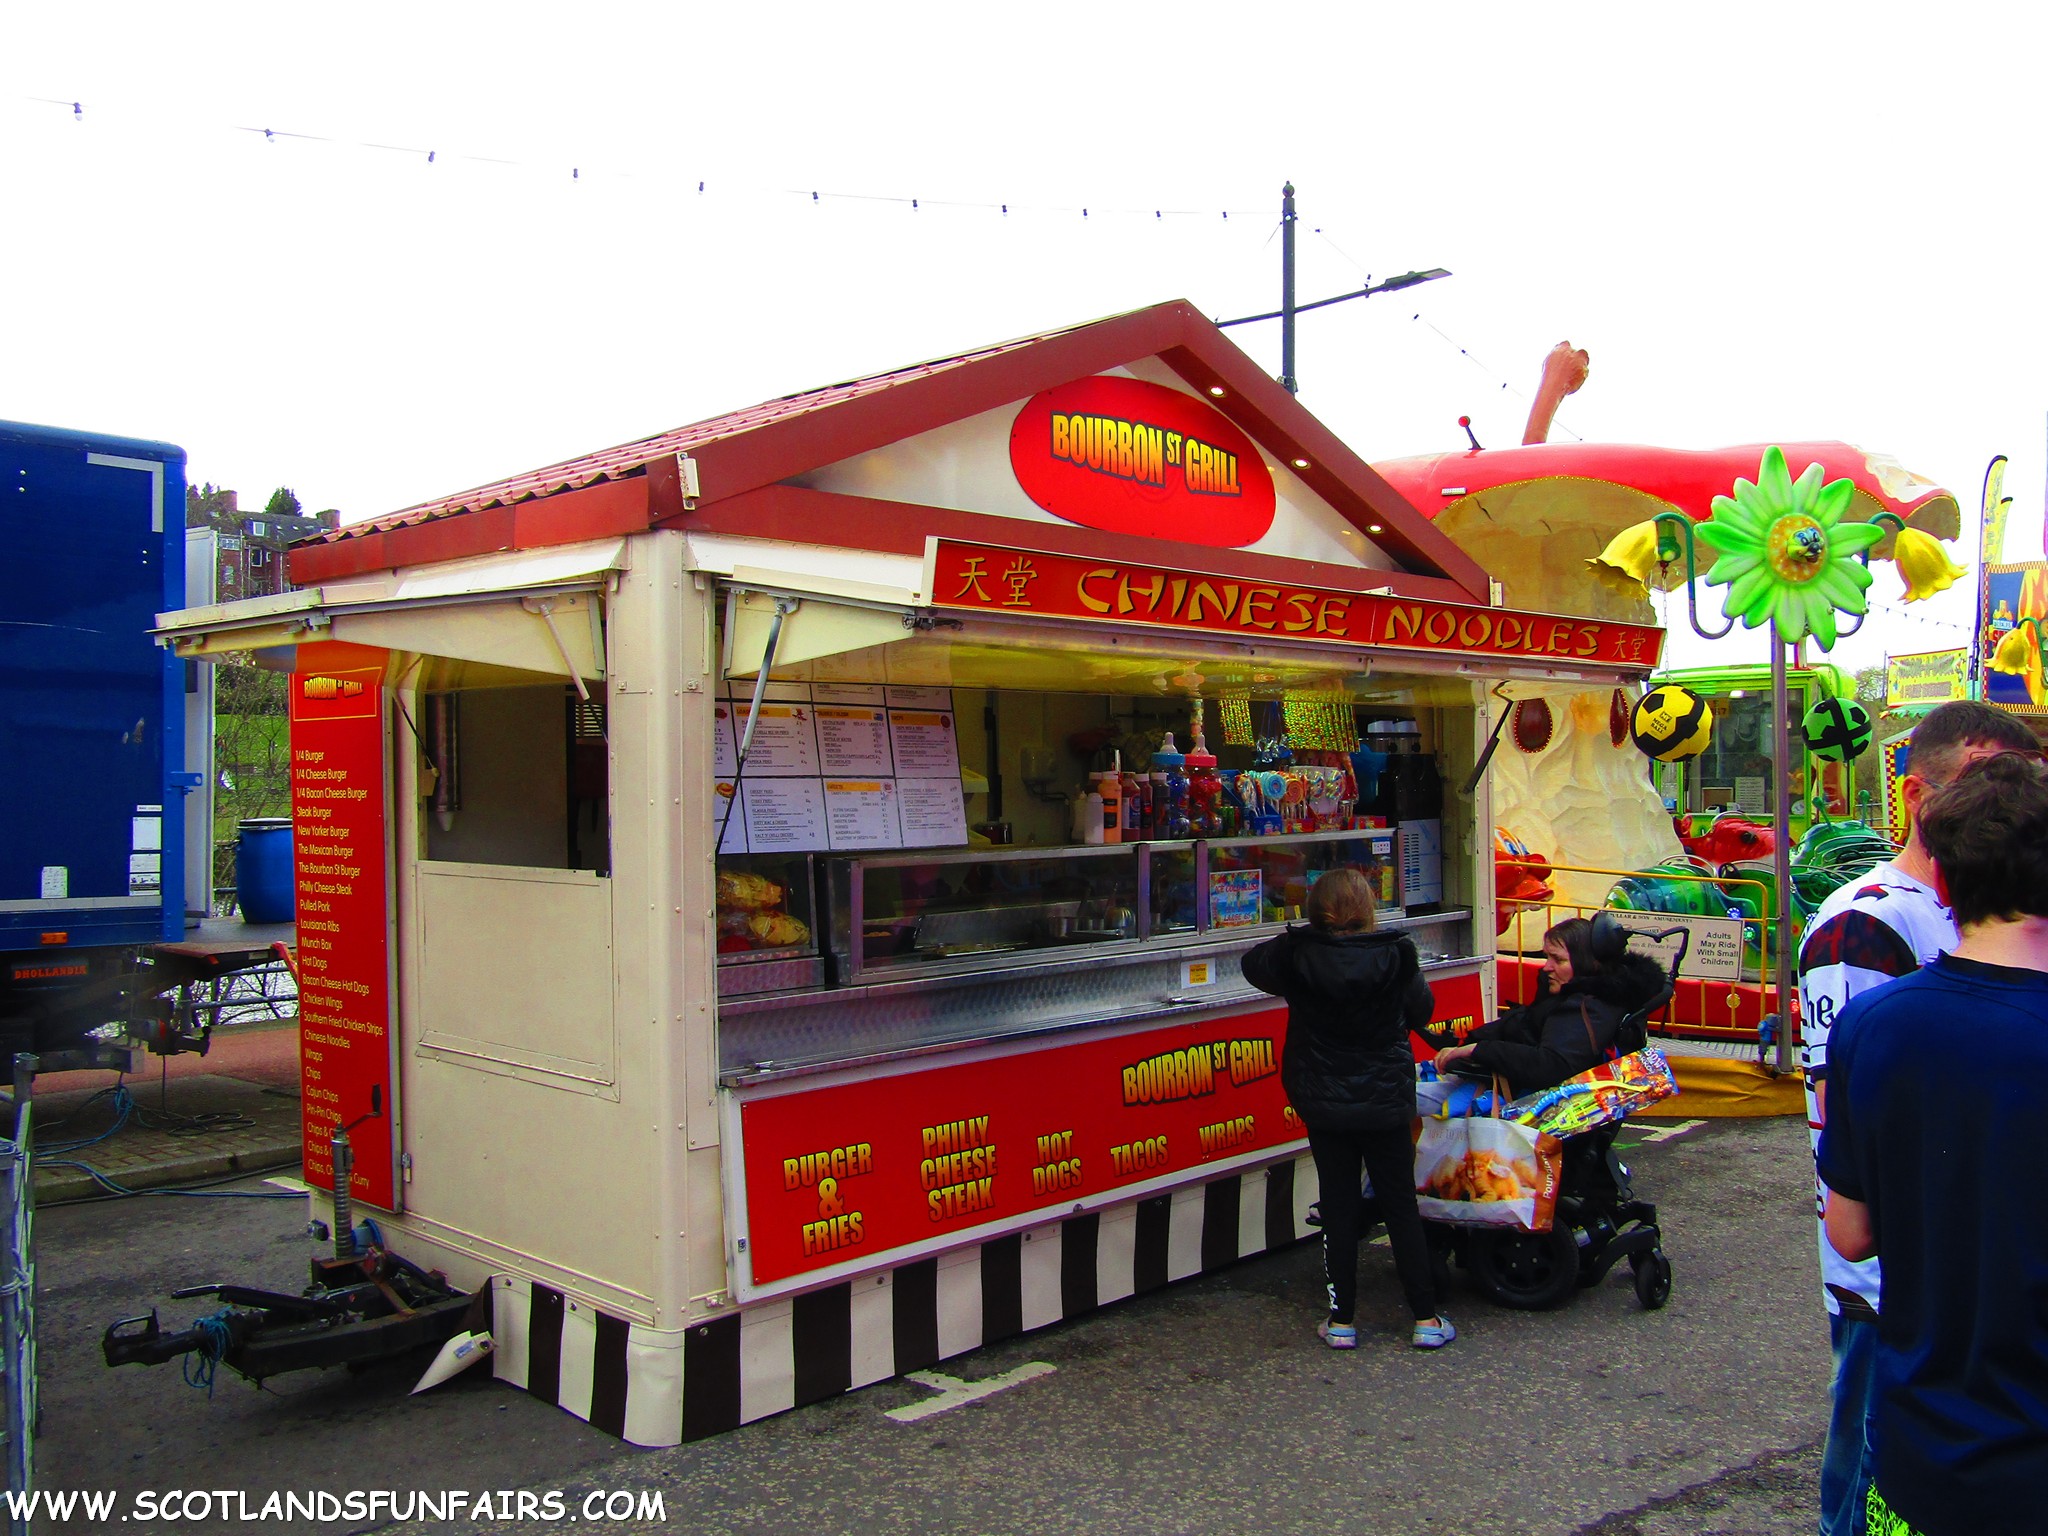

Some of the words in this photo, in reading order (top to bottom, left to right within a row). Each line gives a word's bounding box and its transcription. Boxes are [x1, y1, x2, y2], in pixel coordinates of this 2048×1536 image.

[1051, 412, 1164, 486] BOURBON
[1166, 431, 1181, 466] ST
[1184, 438, 1240, 494] GRILL
[953, 556, 1037, 606] 天堂
[1077, 568, 1352, 637] CHINESE
[1384, 605, 1600, 656] NOODLES
[1650, 723, 1662, 734] BALL
[1653, 718, 1667, 730] MEGA
[305, 750, 324, 762] Burger
[306, 769, 327, 780] Cheese
[327, 770, 347, 782] Burger
[306, 788, 324, 799] Bacon
[324, 788, 346, 799] Cheese
[347, 789, 367, 801] Burger
[297, 806, 312, 818] Steak
[313, 808, 332, 820] Burger
[310, 826, 327, 838] Yorker
[328, 826, 349, 840] Burger
[309, 844, 333, 856] Mexican
[333, 846, 353, 859] Burger
[309, 863, 333, 874] Bourbon
[340, 865, 360, 878] Burger
[300, 881, 313, 894] Philly
[314, 882, 335, 894] Cheese
[336, 884, 352, 896] Steak
[300, 900, 316, 911] Pulled
[318, 901, 331, 912] Pork
[300, 918, 327, 931] Louisiana
[328, 921, 340, 932] Ribs
[302, 938, 319, 950] Munch
[1700, 940, 1716, 949] May
[1718, 941, 1736, 949] Ride
[1717, 949, 1739, 957] Small
[312, 958, 327, 970] Dogs
[1701, 958, 1734, 966] Children
[303, 974, 320, 987] Bacon
[321, 976, 341, 989] Cheese
[353, 982, 370, 996] Dogs
[303, 992, 324, 1006] Chicken
[325, 996, 343, 1010] Wings
[304, 1011, 327, 1024] Southern
[328, 1014, 342, 1028] Fried
[343, 1018, 366, 1032] Chicken
[367, 1022, 383, 1036] Strips
[305, 1029, 326, 1043] Chinese
[326, 1033, 350, 1049] Noodles
[305, 1048, 323, 1062] Wraps
[306, 1066, 321, 1080] Chips
[1122, 1043, 1214, 1105] BOURBON
[1214, 1040, 1228, 1071] ST
[1229, 1038, 1278, 1087] GRILL
[306, 1084, 322, 1099] Cajun
[323, 1088, 339, 1103] Chips
[326, 1108, 342, 1124] Chips
[308, 1122, 322, 1137] Chips
[1199, 1115, 1255, 1154] WRAPS
[922, 1115, 989, 1160] PHILLY
[308, 1140, 323, 1154] Chips
[1037, 1130, 1073, 1162] HOT
[1110, 1135, 1168, 1178] TACOS
[783, 1142, 872, 1192] BURGER
[920, 1144, 998, 1193] CHEESE
[354, 1172, 370, 1190] Curry
[1032, 1158, 1082, 1196] DOGS
[818, 1176, 844, 1220] &
[928, 1176, 995, 1222] STEAK
[802, 1211, 864, 1257] FRIES
